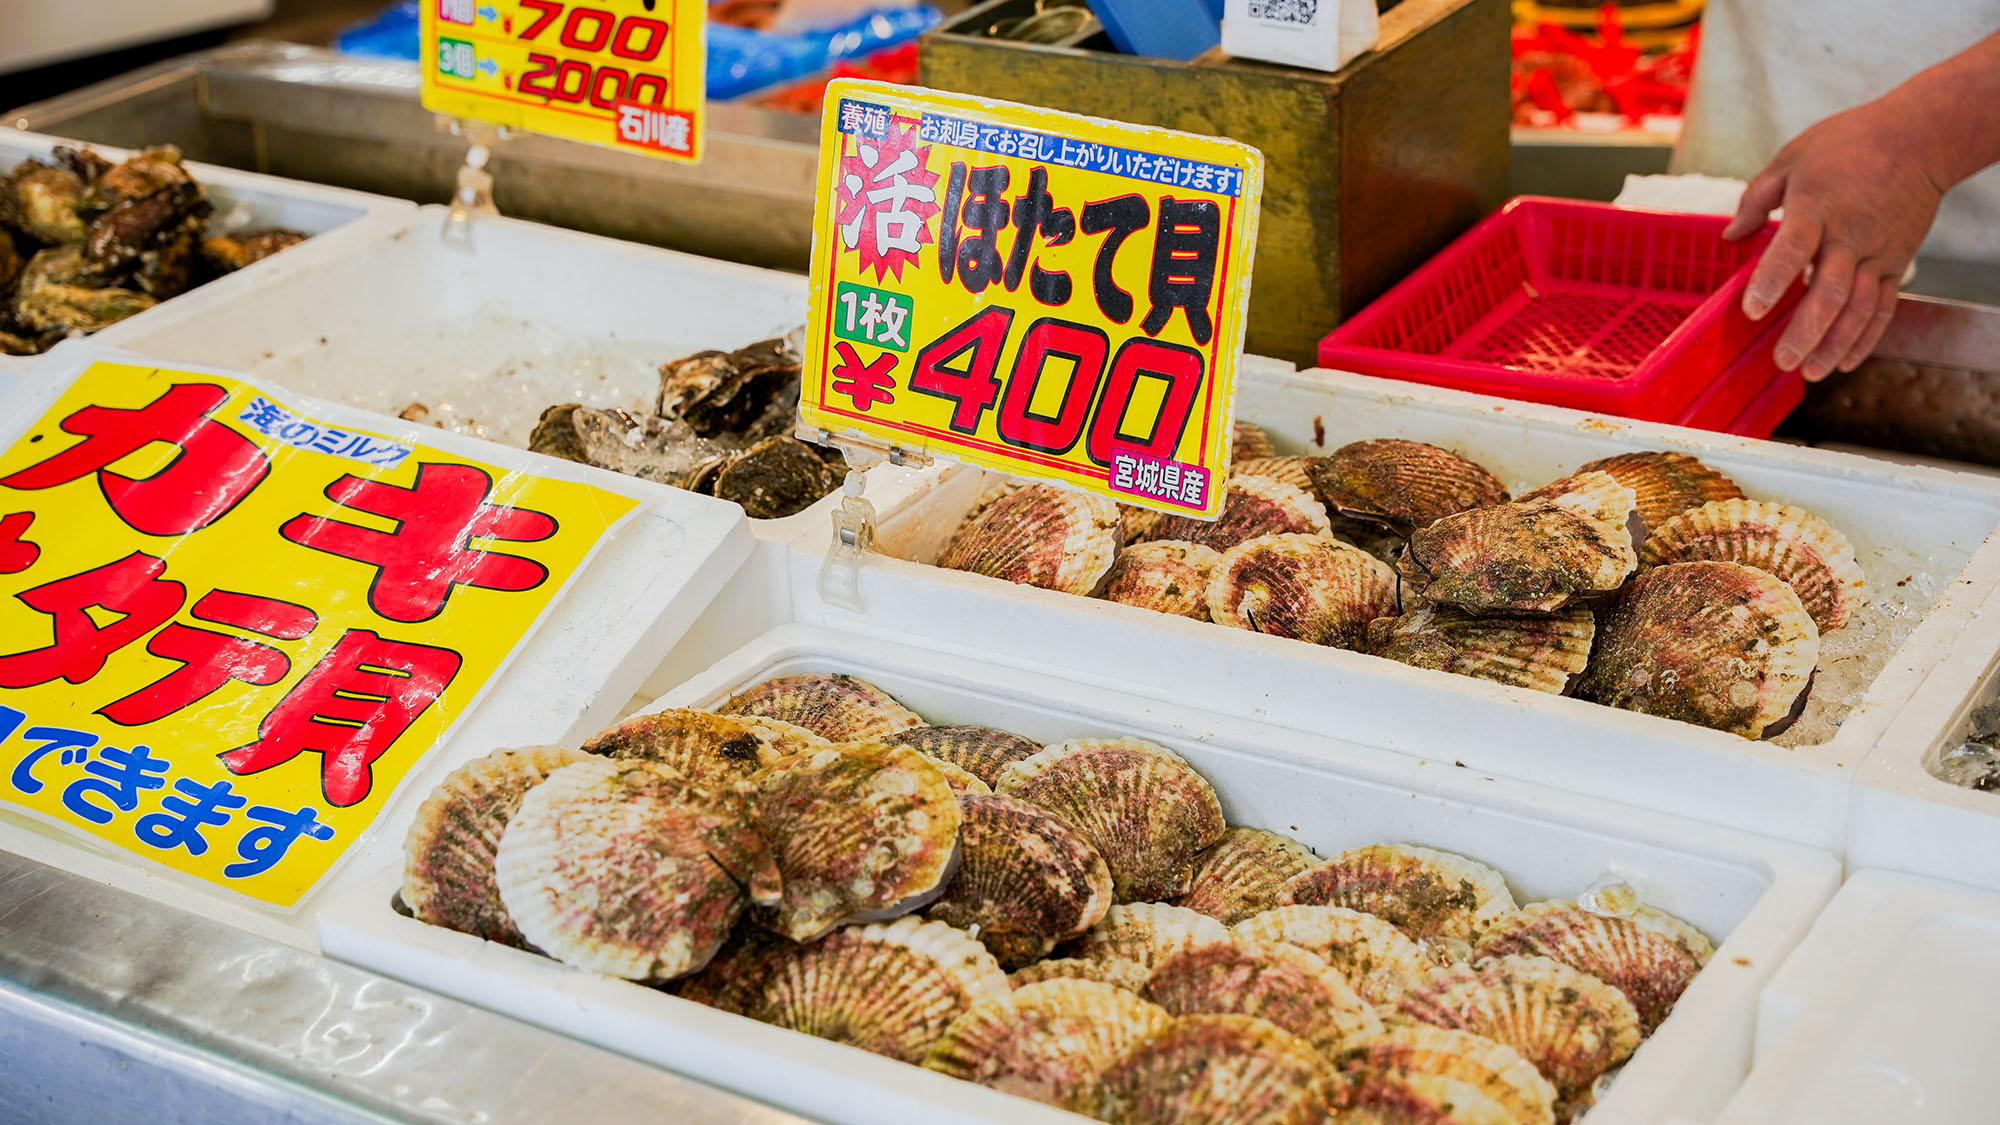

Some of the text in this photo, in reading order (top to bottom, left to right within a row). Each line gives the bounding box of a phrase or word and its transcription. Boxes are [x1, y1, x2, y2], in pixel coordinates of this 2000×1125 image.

[439, 41, 474, 78] 3個
[618, 105, 690, 151] 石川産
[840, 102, 1243, 197] 養殖 お刺身でお召し上がりいただけます!
[840, 143, 937, 258] 活
[938, 161, 1221, 347] ほたて貝
[839, 290, 908, 348] 1枚
[240, 397, 411, 465] 海のミルク
[0, 382, 559, 624] カキ
[1113, 453, 1205, 506] 宮城県産
[0, 511, 463, 808] タテ貝
[0, 705, 336, 879] できます
